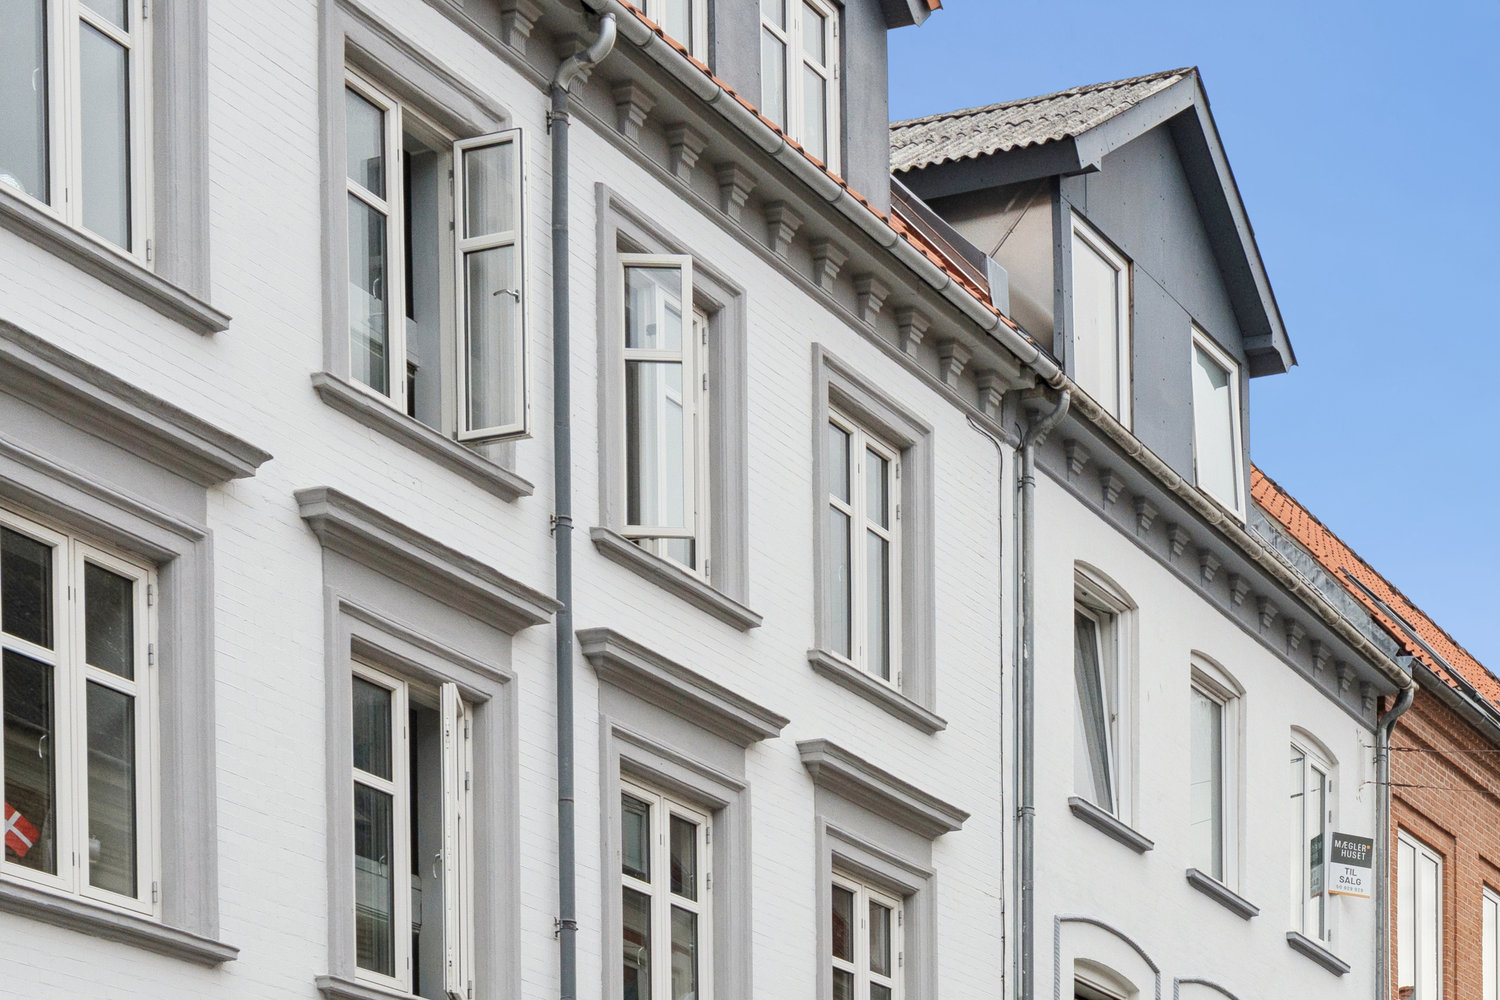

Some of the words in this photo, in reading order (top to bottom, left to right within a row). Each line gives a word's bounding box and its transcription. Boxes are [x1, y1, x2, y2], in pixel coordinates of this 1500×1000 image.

[1334, 840, 1367, 852] MÆGLER
[1341, 849, 1366, 860] HUSET
[1345, 867, 1357, 876] TIL
[1339, 876, 1361, 886] SALG
